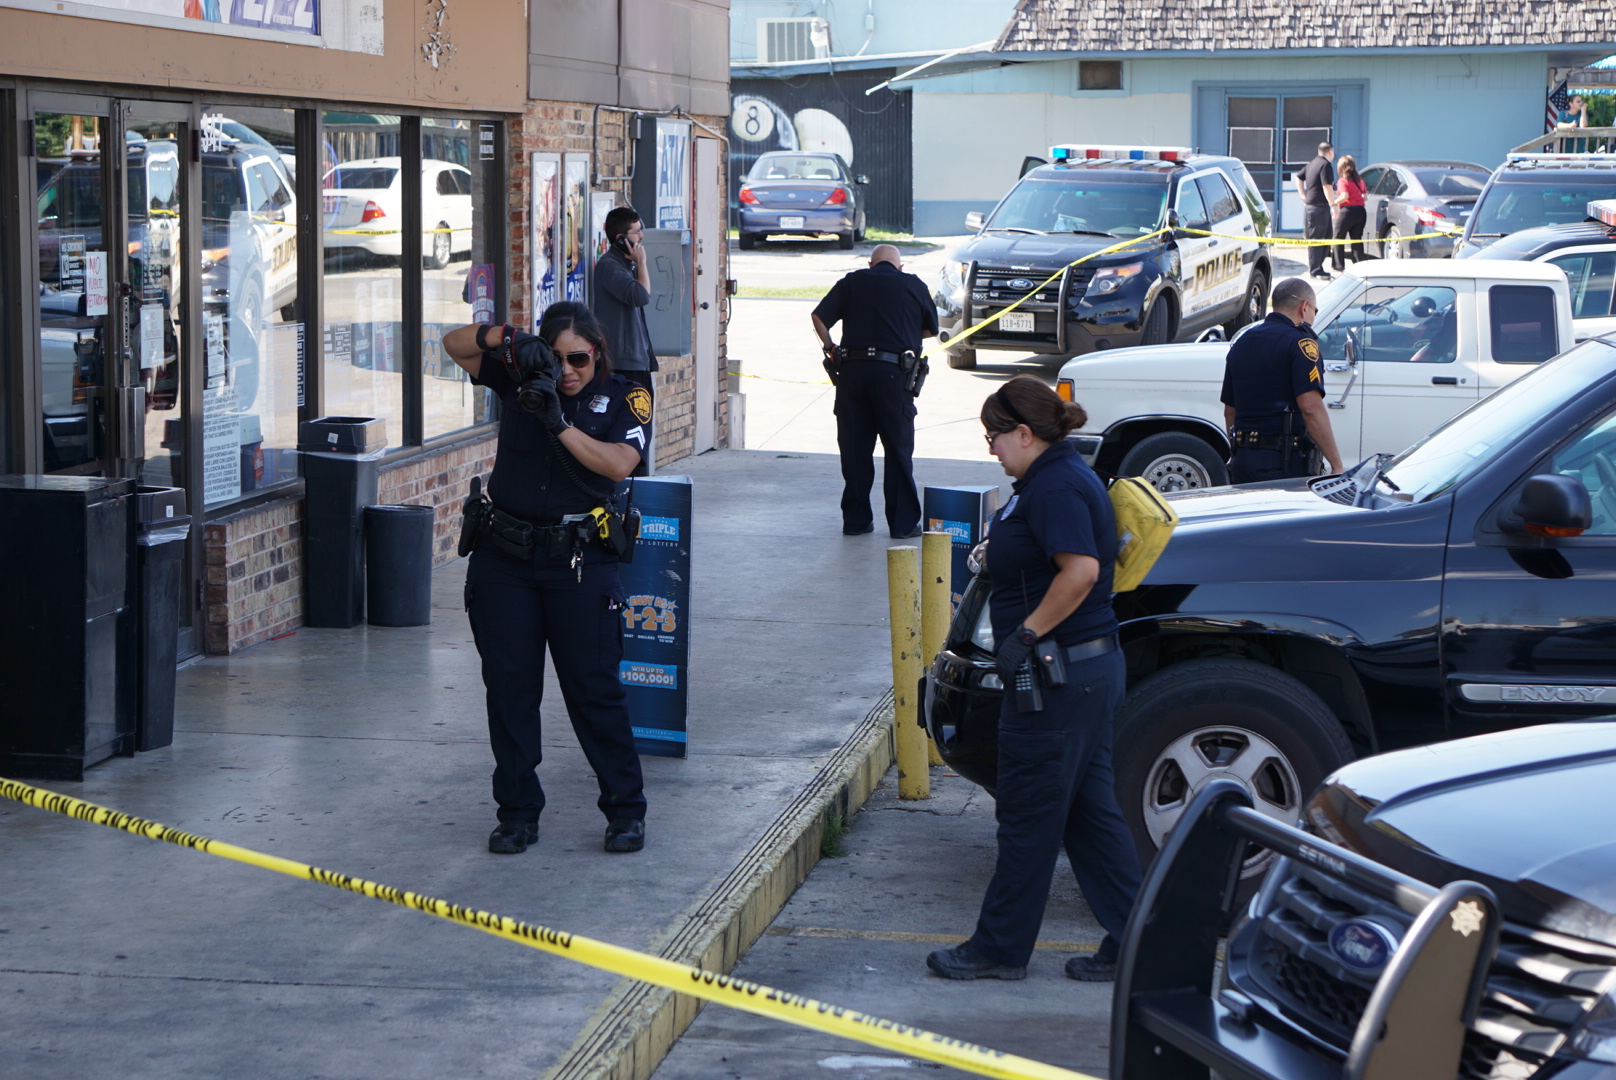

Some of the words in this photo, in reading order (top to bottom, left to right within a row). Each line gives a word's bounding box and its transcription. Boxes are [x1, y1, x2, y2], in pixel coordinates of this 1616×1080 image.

[745, 106, 760, 135] 8
[659, 134, 686, 197] ATM
[90, 256, 101, 275] NO
[1192, 246, 1242, 297] POLICE
[1001, 319, 1032, 328] 118-6771
[642, 523, 676, 535] TRIPLE
[629, 595, 655, 607] EASY
[654, 596, 668, 609] AS
[622, 606, 677, 632] 1-2-3
[621, 671, 675, 685] $100,000!
[1500, 686, 1606, 702] ENVOY
[75, 803, 97, 823] DO
[1298, 843, 1346, 875] SETINA
[1336, 925, 1380, 964] Ford
